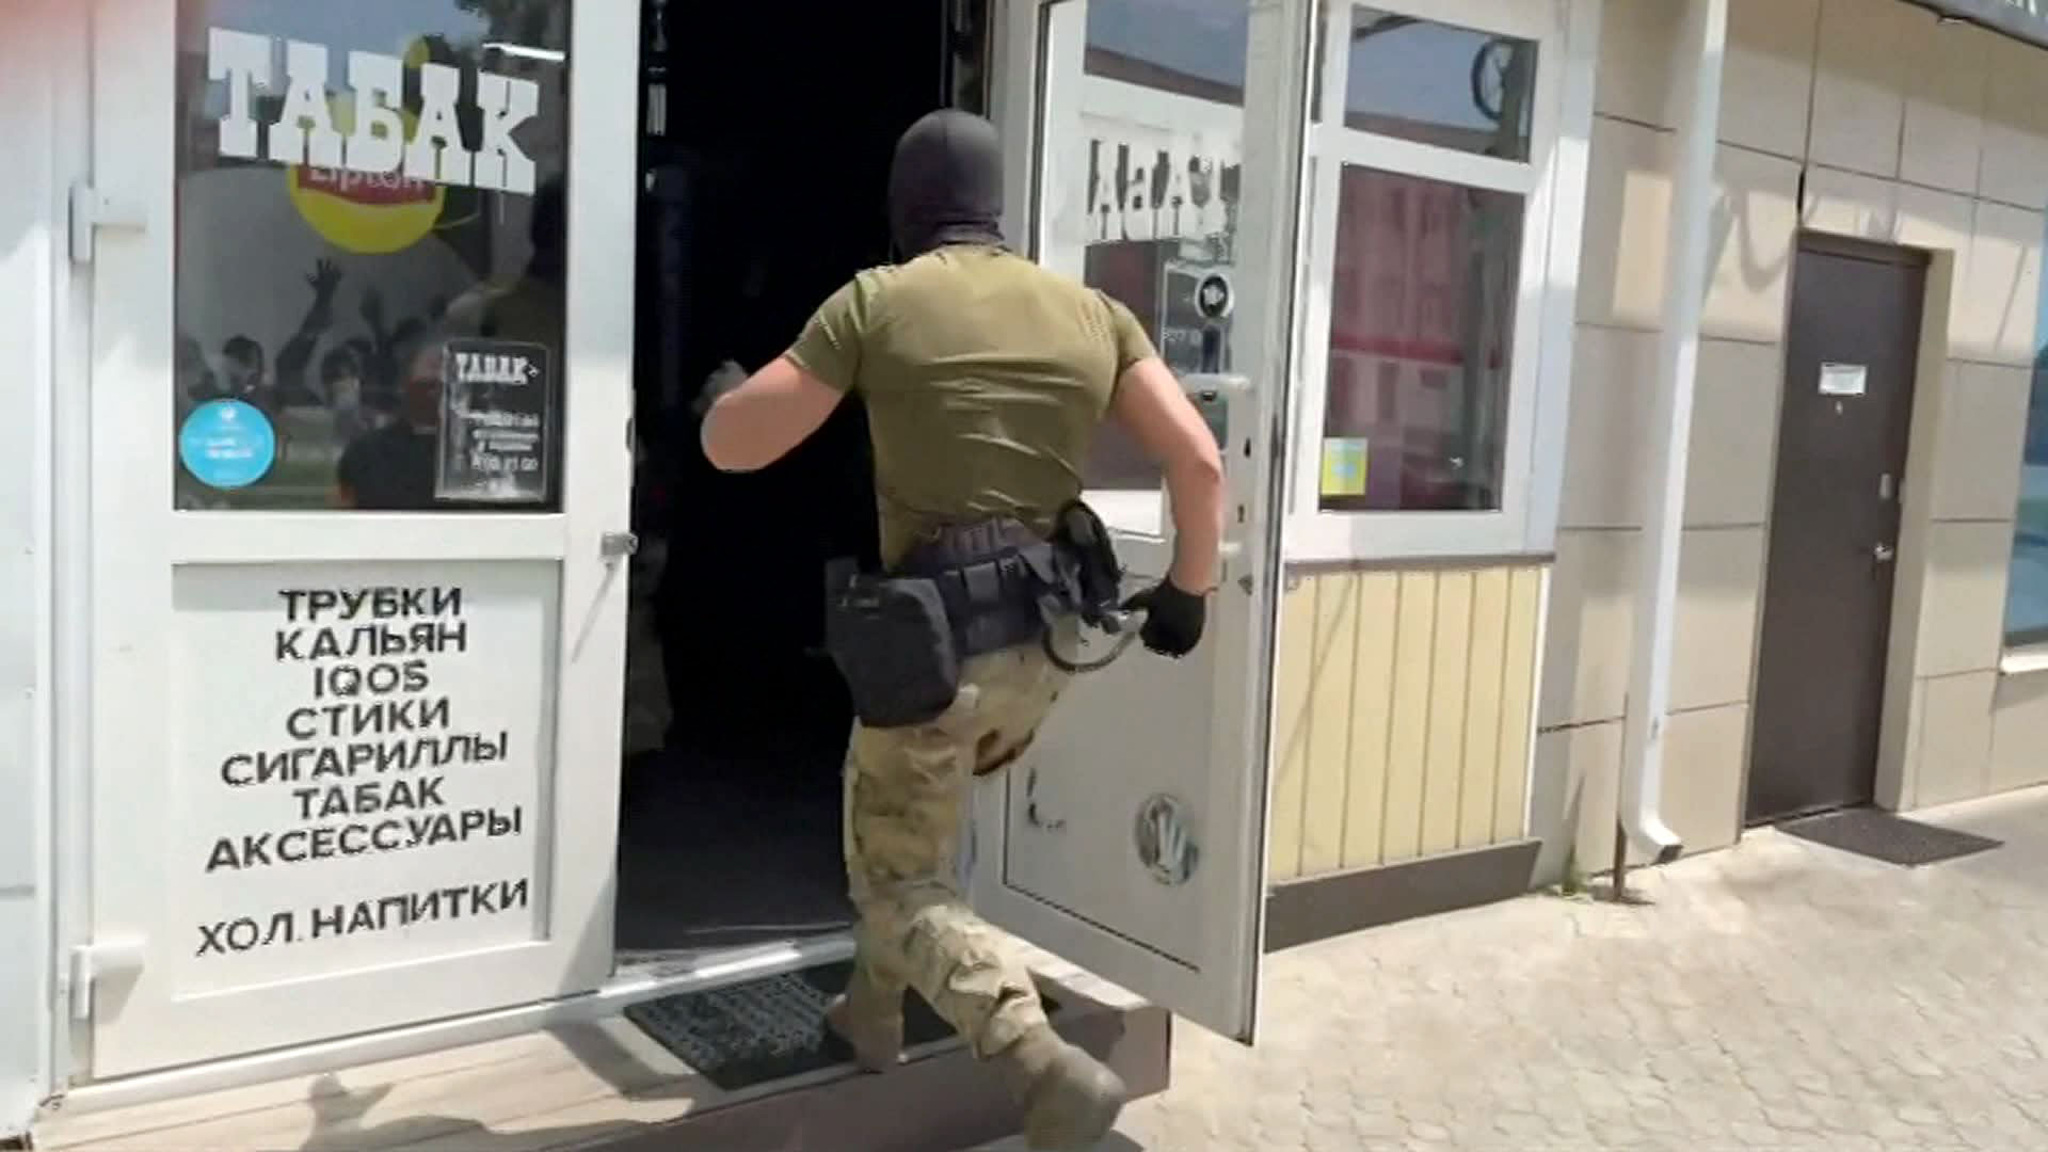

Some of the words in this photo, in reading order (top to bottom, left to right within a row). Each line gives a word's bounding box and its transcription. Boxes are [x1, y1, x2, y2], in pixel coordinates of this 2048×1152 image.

[208, 26, 540, 196] ТАБАК
[278, 586, 463, 621] ТРУБКИ
[275, 622, 467, 660] КАЛЬЯН
[313, 660, 429, 698] IQOS
[286, 697, 449, 741] СТИКИ
[220, 731, 508, 787] СИГАРИЛЛЫ
[292, 776, 445, 820] ТАБАК
[205, 806, 523, 873] АКСЕССУАРЫ
[311, 878, 529, 938] НАПИТКИ
